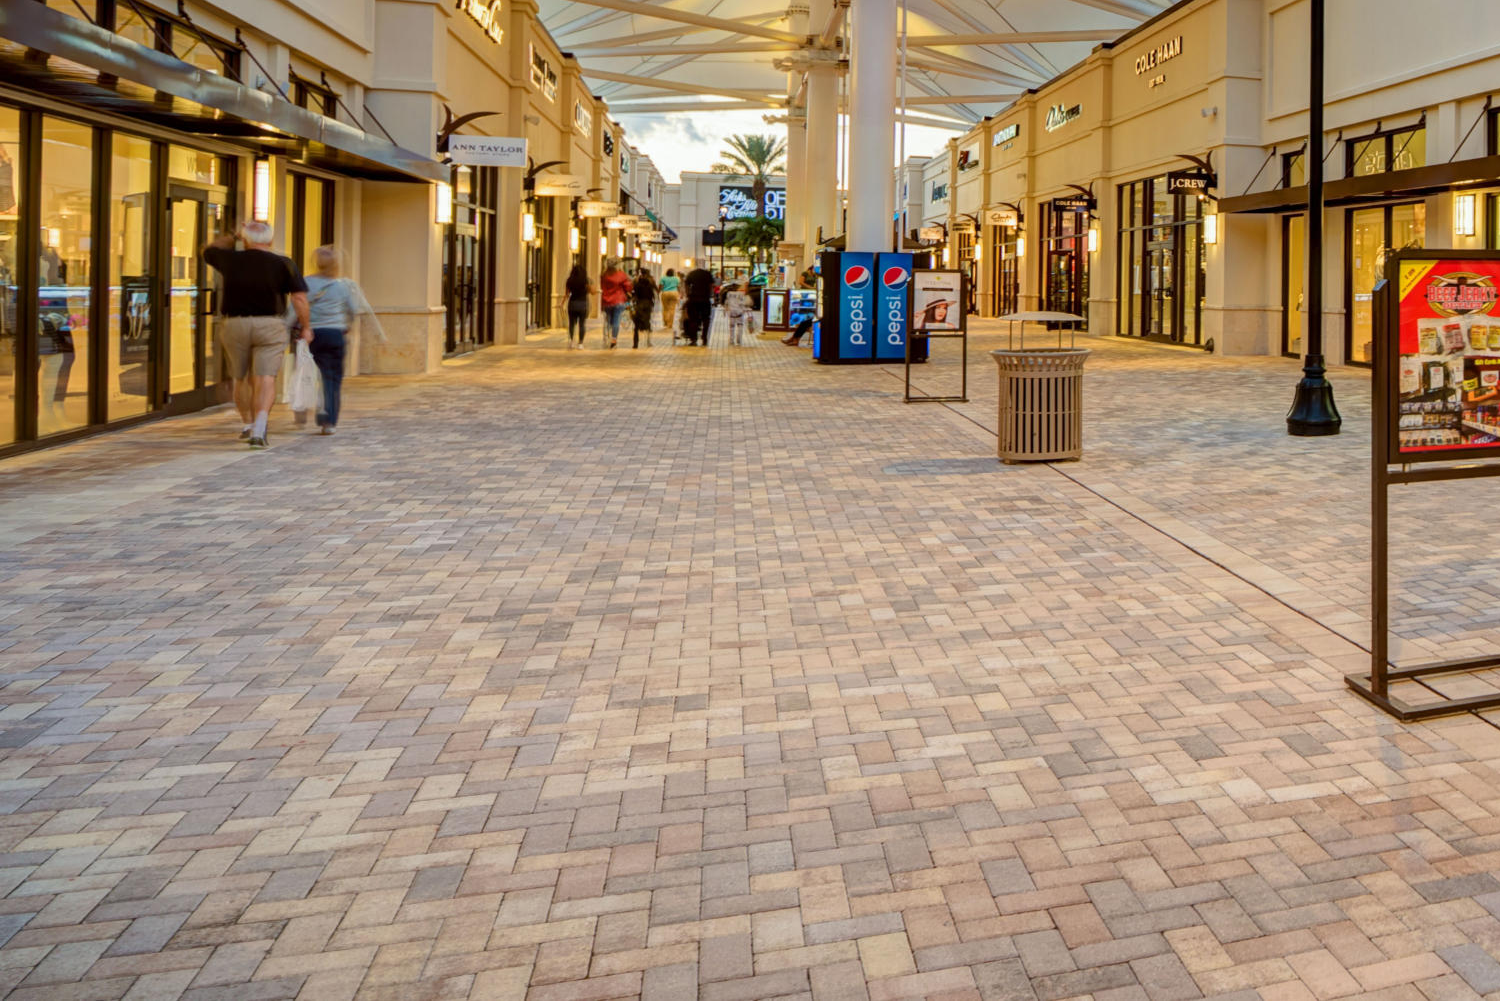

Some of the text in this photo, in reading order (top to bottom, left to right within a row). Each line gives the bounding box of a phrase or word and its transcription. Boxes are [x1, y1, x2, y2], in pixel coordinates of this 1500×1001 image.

[1135, 35, 1183, 75] COLE HAAN
[480, 145, 523, 153] TAYLOR
[1171, 178, 1207, 190] J.CREW
[1427, 284, 1497, 302] BEEF JERKY
[848, 293, 867, 345] pepsi
[886, 295, 904, 345] pepsi
